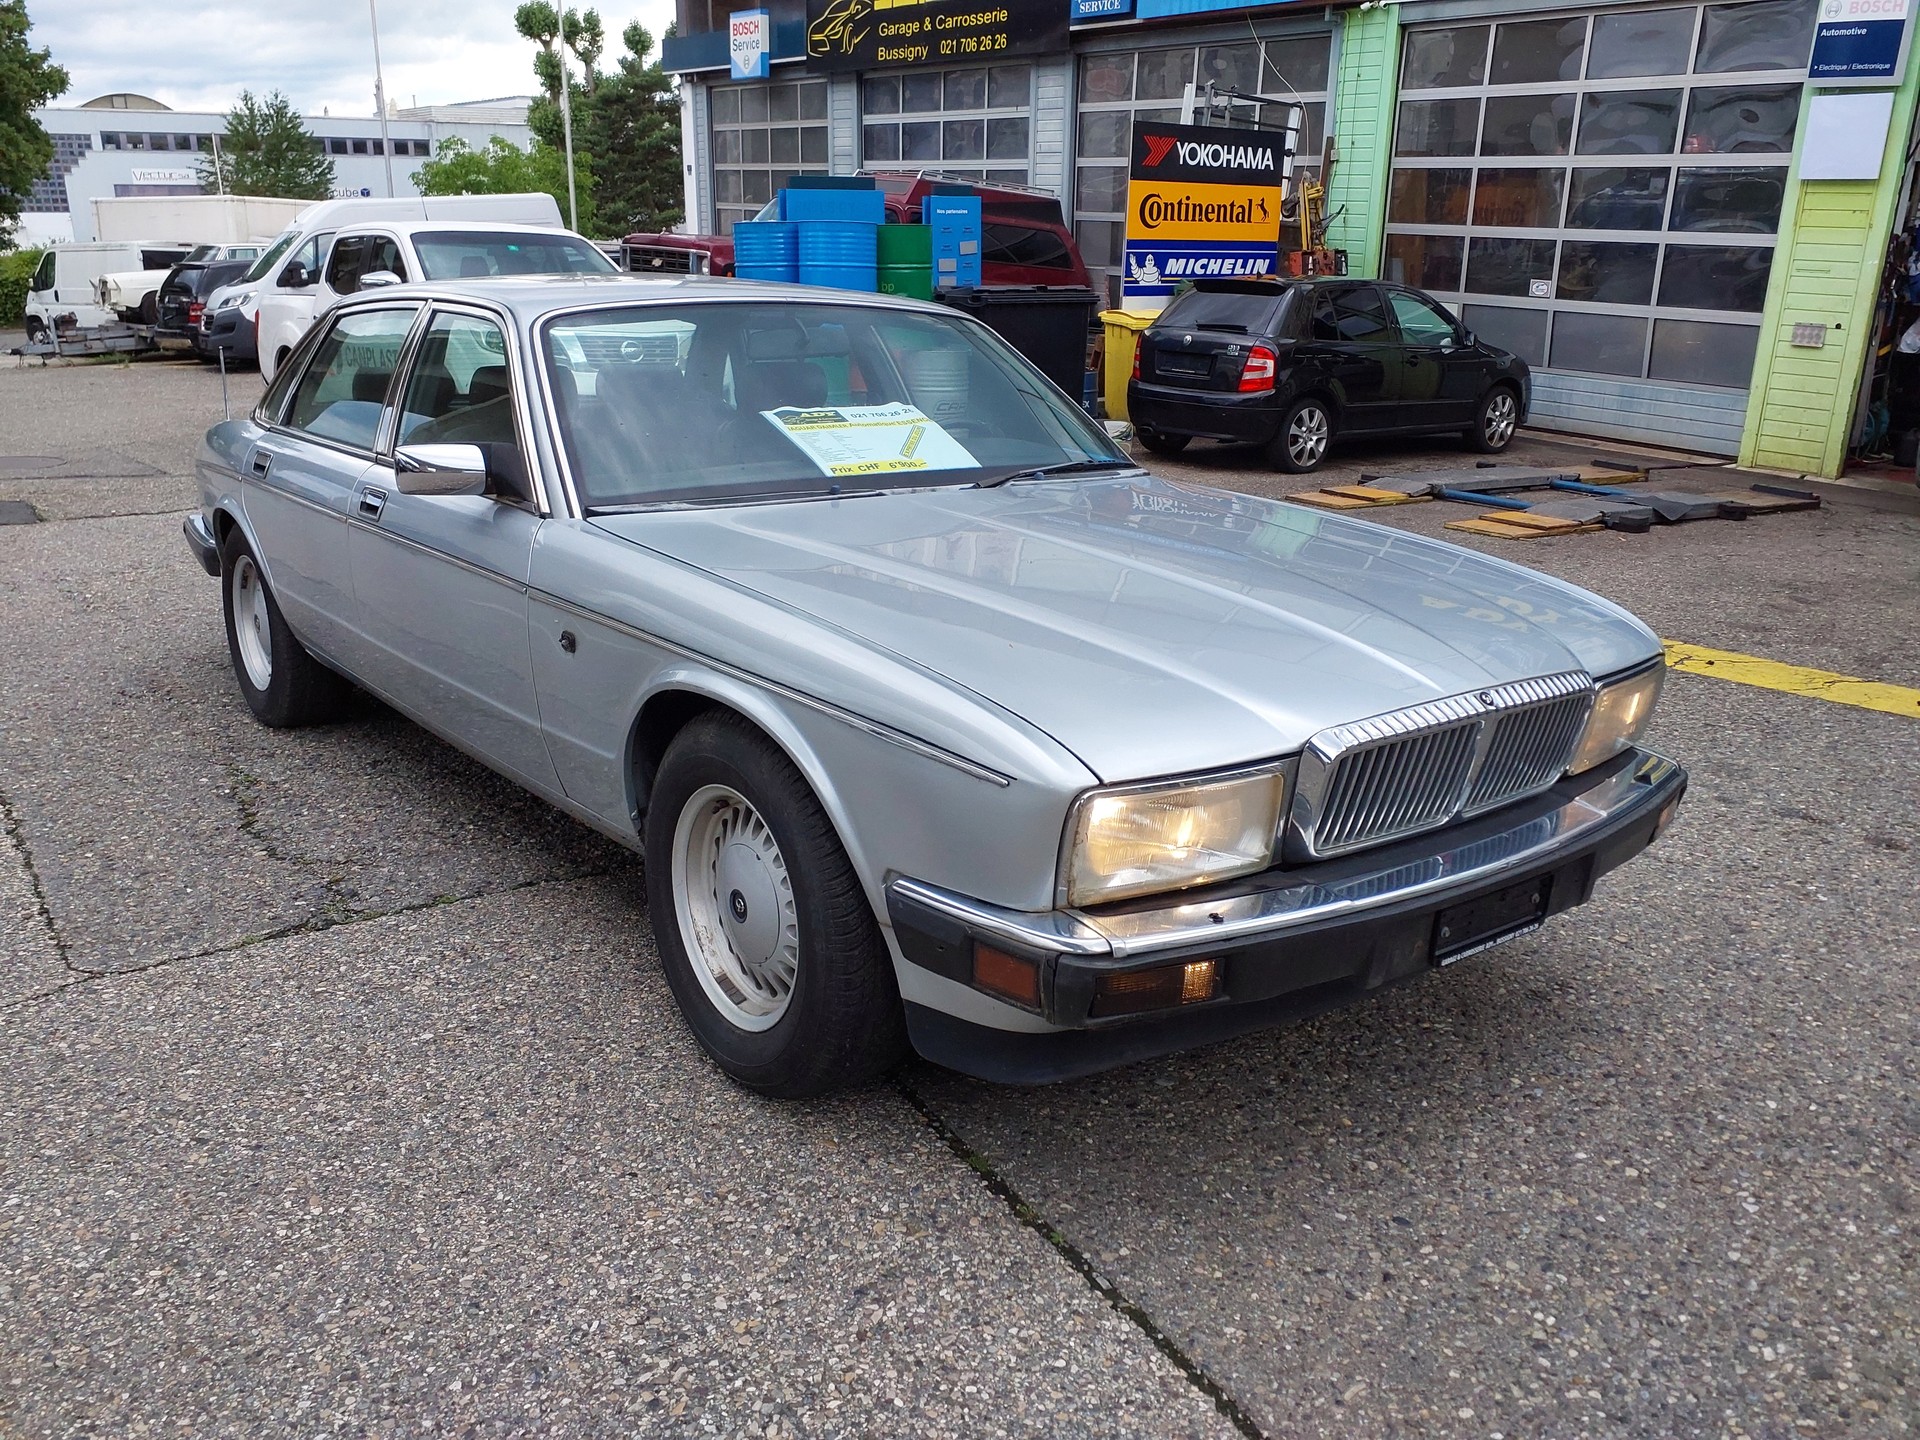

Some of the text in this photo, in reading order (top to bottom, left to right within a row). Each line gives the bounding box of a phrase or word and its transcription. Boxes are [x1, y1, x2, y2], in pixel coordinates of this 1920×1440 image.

[1079, 0, 1120, 13] SERVICE
[1849, 0, 1904, 14] BOSCH
[732, 20, 760, 36] BOSCH
[879, 7, 1008, 37] Garage & Carrosserie
[1820, 27, 1867, 37] Automotive
[732, 37, 760, 51] Service
[878, 33, 1007, 61] Bussigny 021 706 26 26
[1176, 141, 1275, 171] YOKOHAMA
[1139, 193, 1253, 229] Continental
[1164, 258, 1270, 275] MICHELIN
[881, 281, 895, 293] bp
[896, 417, 931, 425] ESSENC
[830, 466, 854, 475] Prix
[857, 462, 880, 472] CHF
